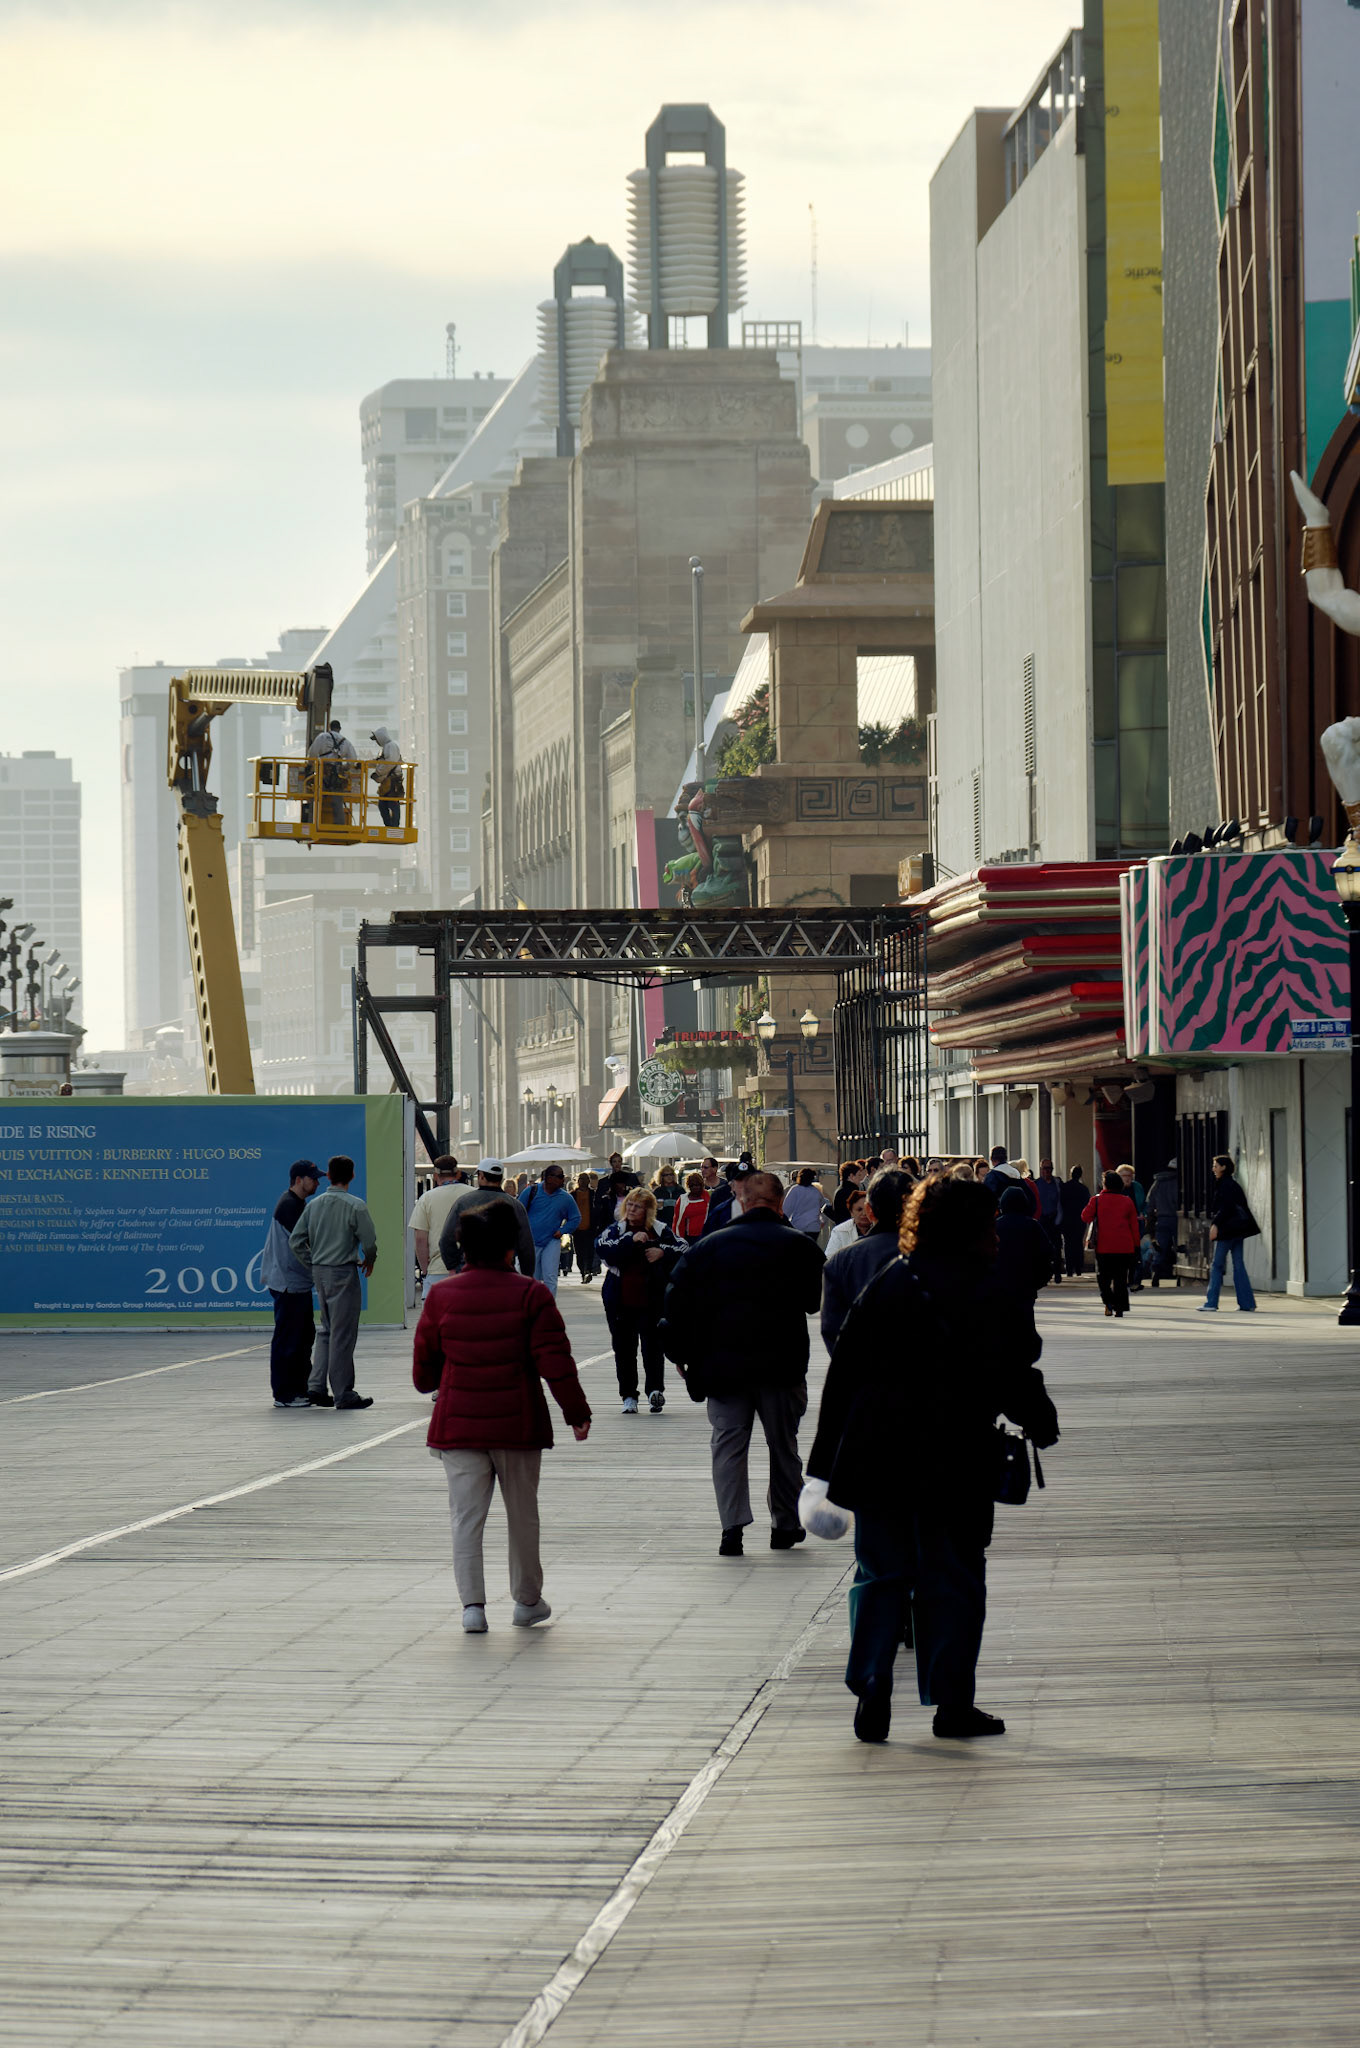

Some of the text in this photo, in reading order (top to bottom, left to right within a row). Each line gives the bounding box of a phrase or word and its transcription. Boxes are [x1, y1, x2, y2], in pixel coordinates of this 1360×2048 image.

[674, 1030, 756, 1041] TRUMP PLA
[1291, 1038, 1348, 1049] Arkansas Ave.
[640, 1063, 681, 1084] STARBKS
[643, 1090, 676, 1105] COFFEE
[28, 1125, 42, 1139] IS
[46, 1125, 96, 1139] RISING
[0, 1149, 24, 1160] UIS
[27, 1149, 92, 1160] VUITTON
[103, 1148, 173, 1160] BURBERRY
[183, 1148, 225, 1160] HUGO
[229, 1148, 262, 1160] BOSS
[17, 1168, 94, 1180] EXCHANGE
[102, 1168, 169, 1180] KENNETH
[173, 1168, 209, 1180] COLE
[15, 1207, 72, 1216] CONTINENTAL
[73, 1207, 82, 1218] by
[84, 1206, 114, 1218] Stephen
[116, 1207, 136, 1215] Starr
[138, 1206, 147, 1217] of
[148, 1207, 169, 1215] Starr
[170, 1206, 212, 1215] Restaurant
[214, 1206, 267, 1217] Organization
[37, 1220, 45, 1228] IS
[47, 1220, 78, 1228] ITALIAN
[79, 1219, 89, 1230] by
[89, 1219, 115, 1230] Jeffrey
[158, 1218, 168, 1229] of
[168, 1218, 192, 1228] China
[194, 1218, 213, 1228] Grill
[213, 1219, 264, 1230] Management
[17, 1231, 47, 1242] Phillips
[49, 1231, 80, 1240] Famous
[81, 1231, 111, 1242] Seafood
[113, 1231, 122, 1242] of
[123, 1231, 162, 1240] Baltimore
[66, 1244, 76, 1255] by
[77, 1244, 105, 1253] Patrick
[107, 1243, 129, 1254] Lyons
[130, 1243, 139, 1254] of
[141, 1243, 154, 1252] The
[156, 1243, 178, 1254] Lyons
[179, 1243, 205, 1254] Group
[144, 1248, 269, 1294] 2006
[33, 1302, 61, 1311] Brought
[85, 1302, 94, 1310] by
[122, 1302, 144, 1310] Group
[144, 1301, 177, 1309] Holdings,
[208, 1300, 234, 1308] Atlantic
